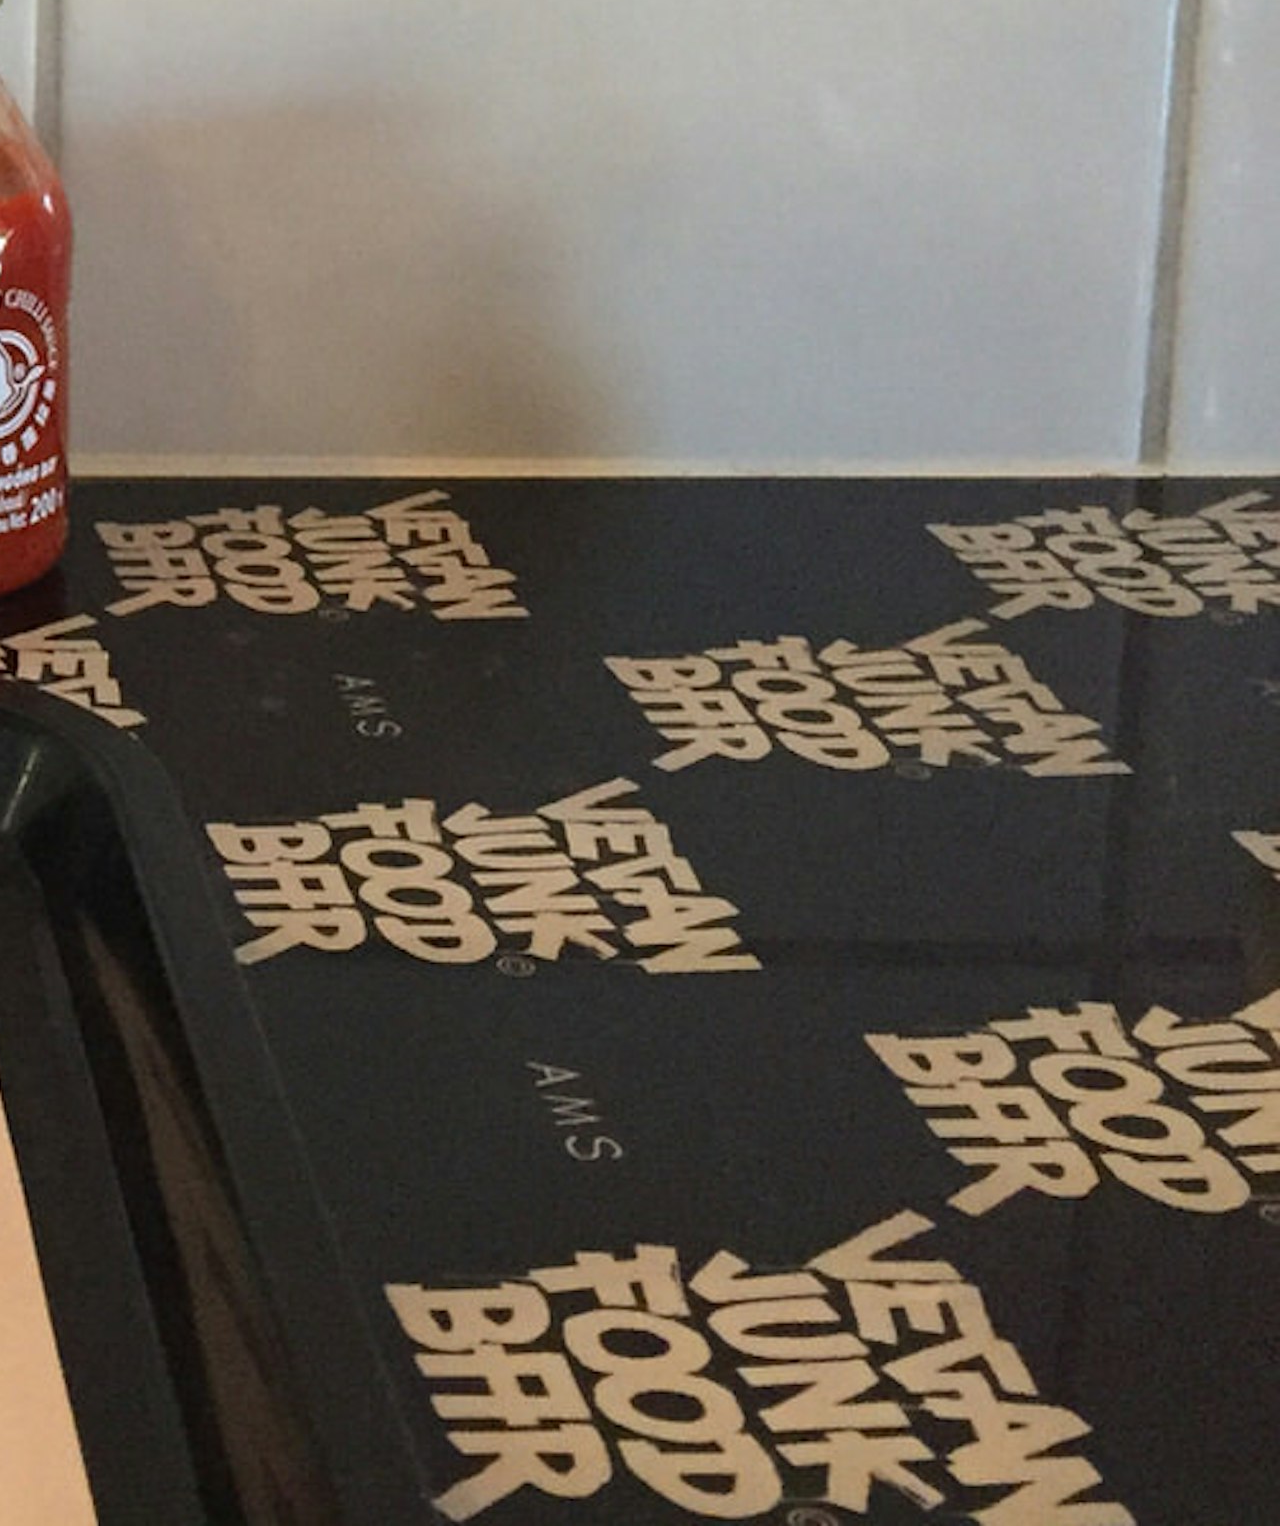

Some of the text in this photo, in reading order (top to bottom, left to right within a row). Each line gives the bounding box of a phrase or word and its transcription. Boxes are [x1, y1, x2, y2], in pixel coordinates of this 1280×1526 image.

[94, 521, 217, 617] BAR
[187, 506, 320, 614] FOOD
[287, 506, 416, 612] JUNK
[338, 674, 403, 740] AMS
[602, 653, 773, 773] BAR
[705, 635, 891, 770] FOOD
[817, 637, 1002, 767] JUNK
[205, 821, 366, 965] BAR
[321, 798, 497, 964] FOOD
[442, 802, 619, 962] JUNK
[526, 1060, 623, 1162] AMS
[384, 1281, 611, 1523] BAR
[529, 1244, 782, 1518] FOOD
[691, 1249, 945, 1514] JUNK
